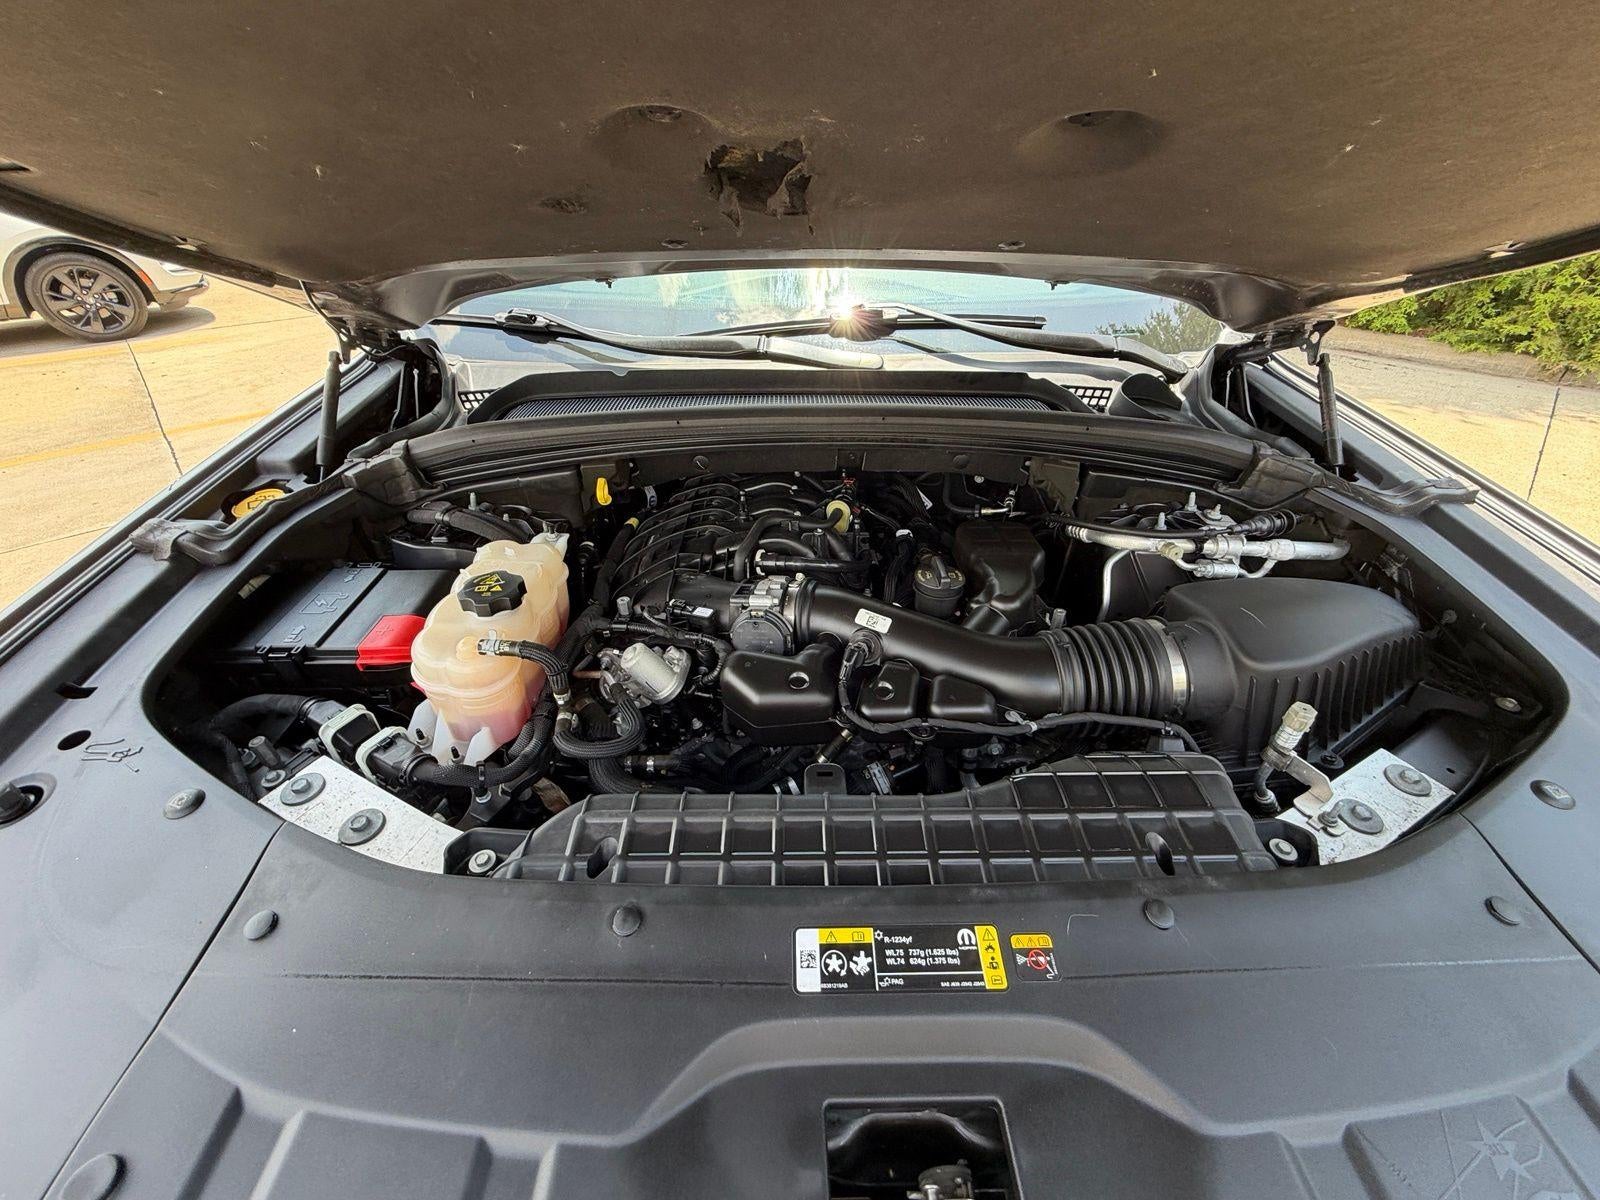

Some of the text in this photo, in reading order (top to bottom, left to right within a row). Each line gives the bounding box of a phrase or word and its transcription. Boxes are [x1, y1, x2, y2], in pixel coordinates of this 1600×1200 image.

[884, 936, 913, 944] R-1234yf
[908, 949, 925, 957] 737g
[946, 948, 959, 956] lbs)
[909, 958, 926, 966] 624g
[947, 957, 961, 966] lbs)
